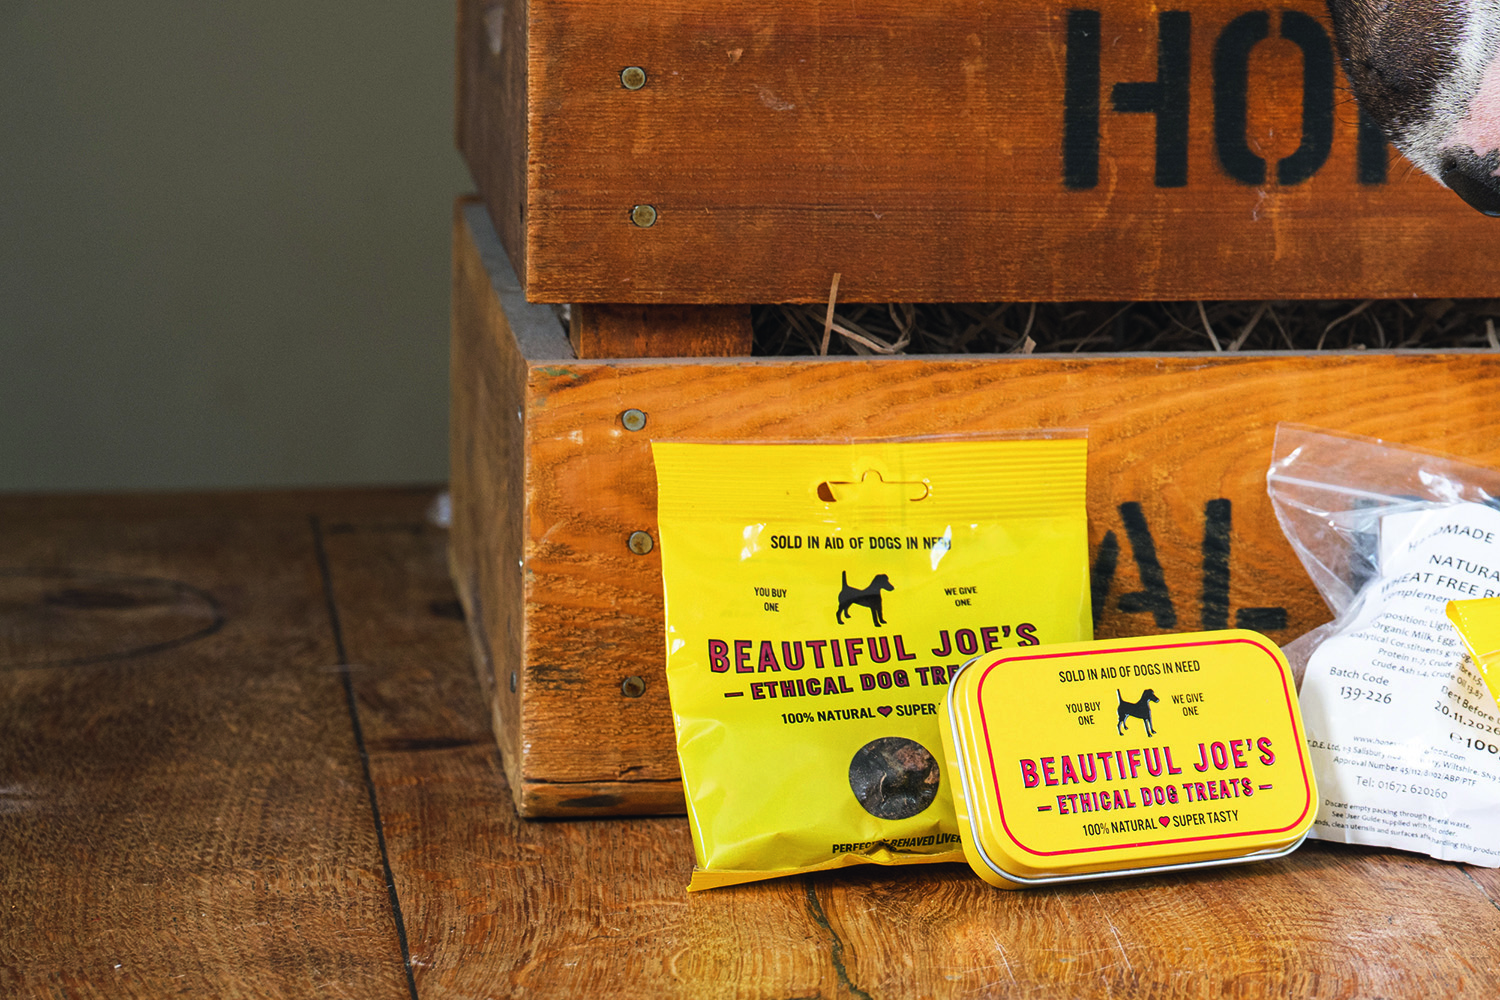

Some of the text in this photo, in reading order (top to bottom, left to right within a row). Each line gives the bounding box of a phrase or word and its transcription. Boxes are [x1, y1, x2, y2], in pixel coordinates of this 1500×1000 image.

[771, 535, 802, 549] SOLD
[807, 536, 820, 549] IN
[824, 536, 845, 549] AID
[849, 536, 864, 550] OF
[869, 536, 901, 550] DOGS
[906, 536, 918, 550] IN
[1092, 497, 1287, 633] AL
[754, 587, 787, 598] YOU BUY
[944, 586, 978, 597] WE GIVE
[1436, 575, 1480, 597] FREE
[764, 602, 779, 613] ONE
[954, 598, 972, 607] ONE
[1372, 620, 1408, 637] Organic
[1429, 618, 1453, 632] Light
[707, 622, 1041, 674] BEAUTIFUL JOE'S
[1378, 647, 1410, 662] Protein
[1429, 658, 1453, 668] Crude
[1059, 660, 1200, 683] SOLD IN AID OF DOGS IN NEED
[1329, 666, 1390, 686] Batch Code
[1371, 658, 1398, 671] Crude
[1399, 664, 1416, 675] Ash
[1431, 670, 1456, 681] Crude
[1456, 676, 1468, 688] Oil
[750, 664, 960, 701] ETHICAL DOG TRE
[1171, 692, 1204, 704] WE GIVE
[1340, 685, 1393, 705] 139-226
[781, 711, 815, 724] 100%
[816, 706, 876, 723] NATURAL
[896, 703, 937, 717] SUPER
[1065, 701, 1101, 713] YOU BUY
[1182, 706, 1199, 717] ONE
[1462, 698, 1495, 723] Before
[1077, 714, 1095, 726] ONE
[1019, 736, 1276, 789] BEAUTIFUL JOE'S
[1333, 756, 1367, 768] Approval
[1368, 761, 1399, 772] Number
[1057, 777, 1254, 815] ETHICAL DOG TREATS
[1356, 776, 1448, 799] Tel: 01672 620260
[1332, 810, 1344, 818] See
[1361, 814, 1381, 824] Guide
[1382, 818, 1410, 828] supplied
[1350, 804, 1371, 814] empty
[1372, 807, 1398, 817] packing
[1399, 810, 1427, 821] through
[1082, 809, 1239, 837] 100% NATURAL SUPER TASTY
[832, 832, 962, 854] PERFEC BEHAVED LIVER
[1314, 819, 1331, 828] ands,
[1331, 821, 1349, 829] clean
[1350, 823, 1376, 832] utensils
[1390, 829, 1419, 838] surfaces
[1431, 837, 1459, 850] handling
[1459, 842, 1472, 851] this
[1472, 846, 1500, 856] product
